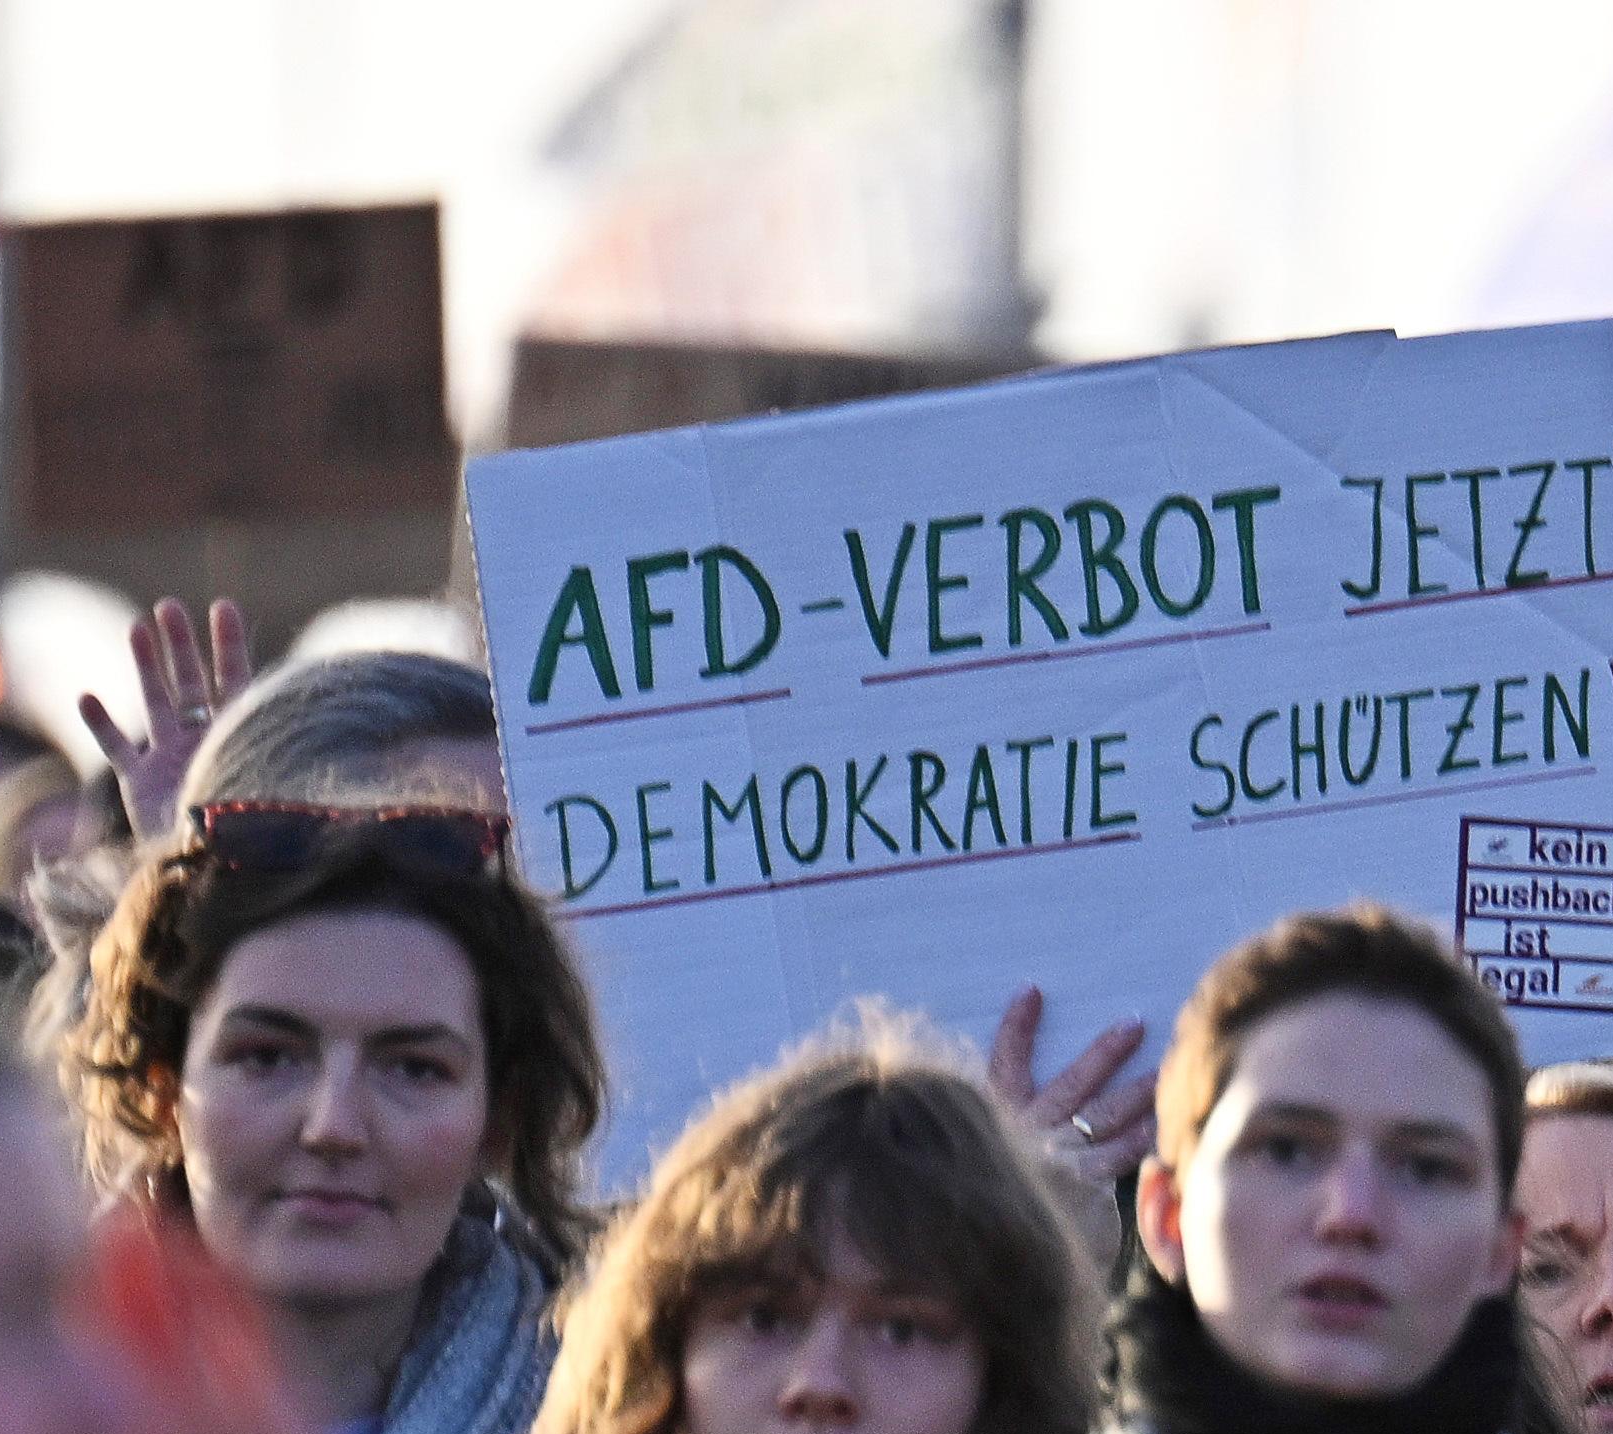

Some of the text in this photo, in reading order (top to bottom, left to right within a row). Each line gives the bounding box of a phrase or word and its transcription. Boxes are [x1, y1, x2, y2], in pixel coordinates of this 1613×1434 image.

[527, 485, 1282, 706] AFD-VERBOT
[545, 731, 1138, 900] DEMOKRATIE
[1529, 824, 1607, 866] kein
[1504, 919, 1550, 960] ist
